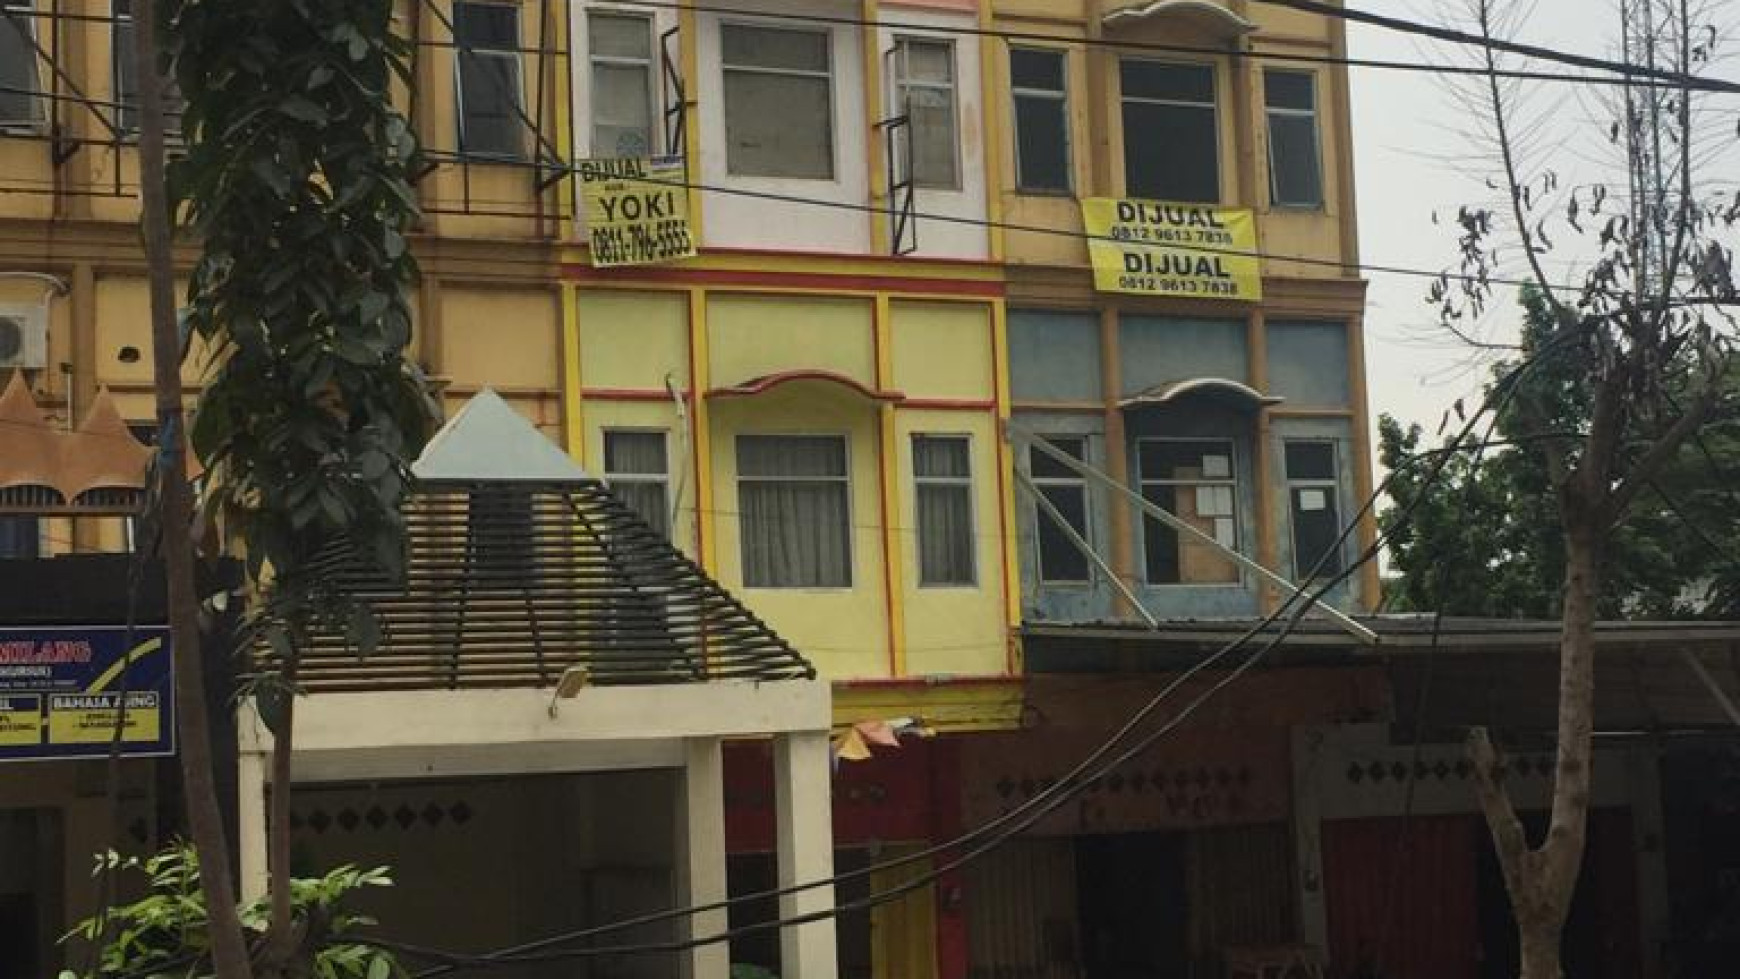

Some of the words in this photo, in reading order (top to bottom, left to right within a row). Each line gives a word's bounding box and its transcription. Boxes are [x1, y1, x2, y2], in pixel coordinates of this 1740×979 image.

[582, 157, 647, 182] DIJUAL
[598, 192, 675, 221] YOKI
[1117, 201, 1224, 229] DIJUAL
[1124, 252, 1231, 279] DIJUAL
[1119, 276, 1156, 291] 0812
